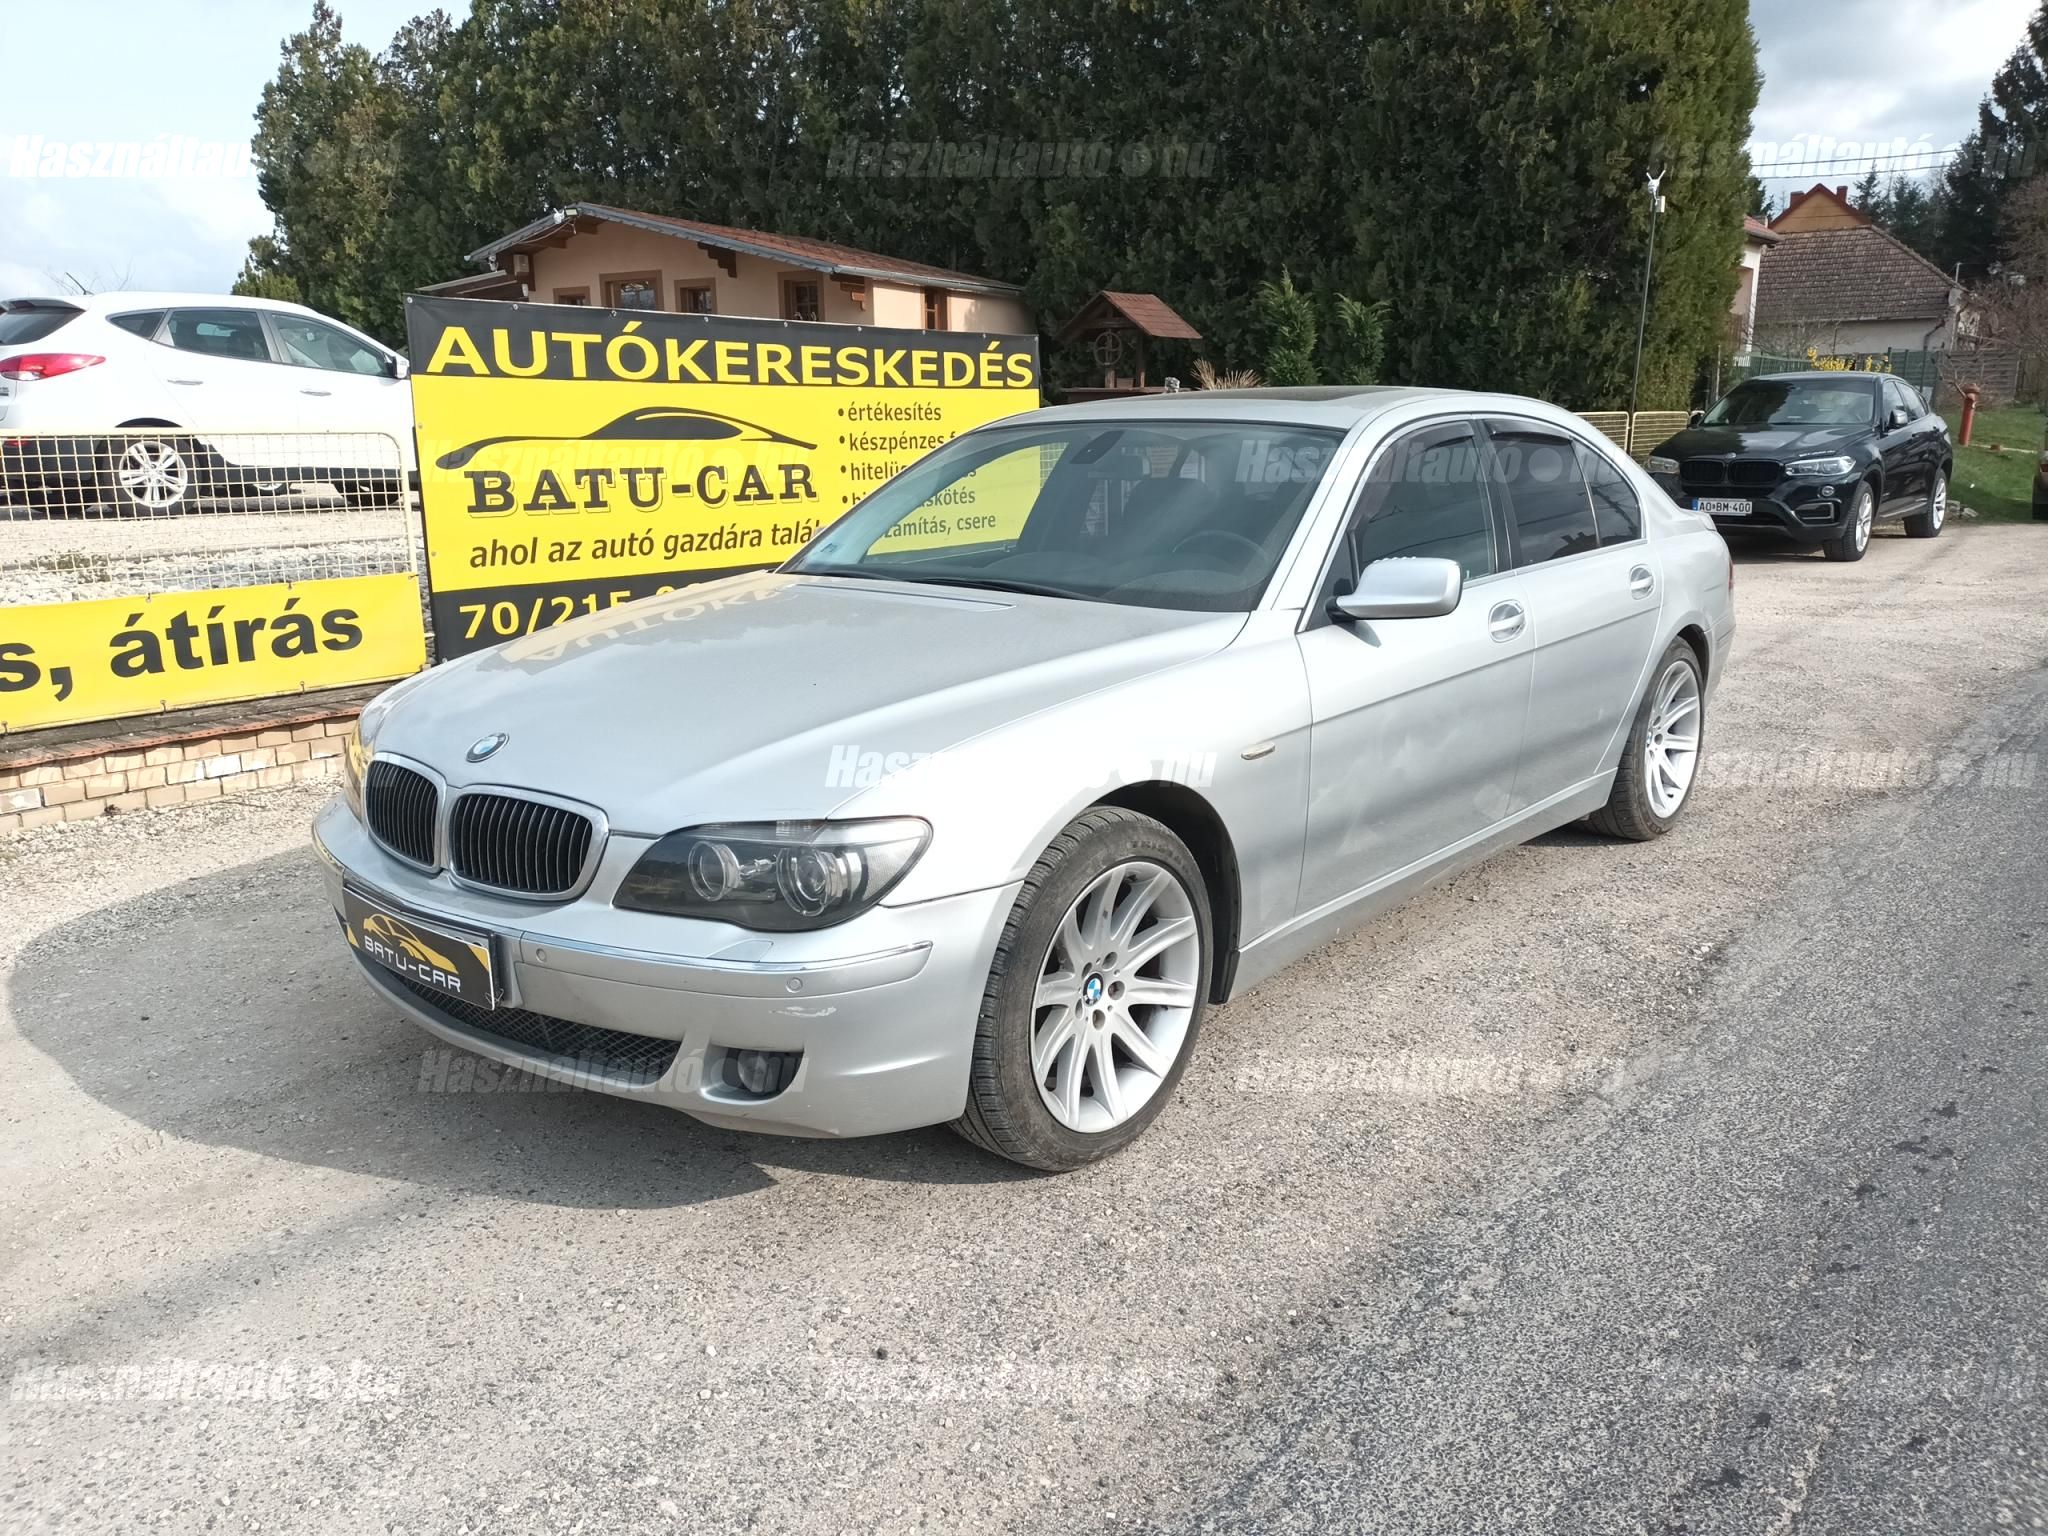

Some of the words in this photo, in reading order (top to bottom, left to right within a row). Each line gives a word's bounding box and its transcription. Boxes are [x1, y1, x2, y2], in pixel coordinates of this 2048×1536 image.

[426, 321, 1034, 388] AUTÓKERESKEDÉS
[847, 401, 942, 421] értékesítés
[849, 431, 945, 454] készpénzes
[463, 463, 820, 518] BATU-CAR
[470, 537, 538, 568] ahol
[547, 540, 582, 562] az
[591, 528, 655, 559] autó
[663, 523, 763, 559] gazdára
[956, 514, 996, 531] csere
[109, 598, 363, 678] átírás
[363, 935, 462, 993] BATU-CAR
